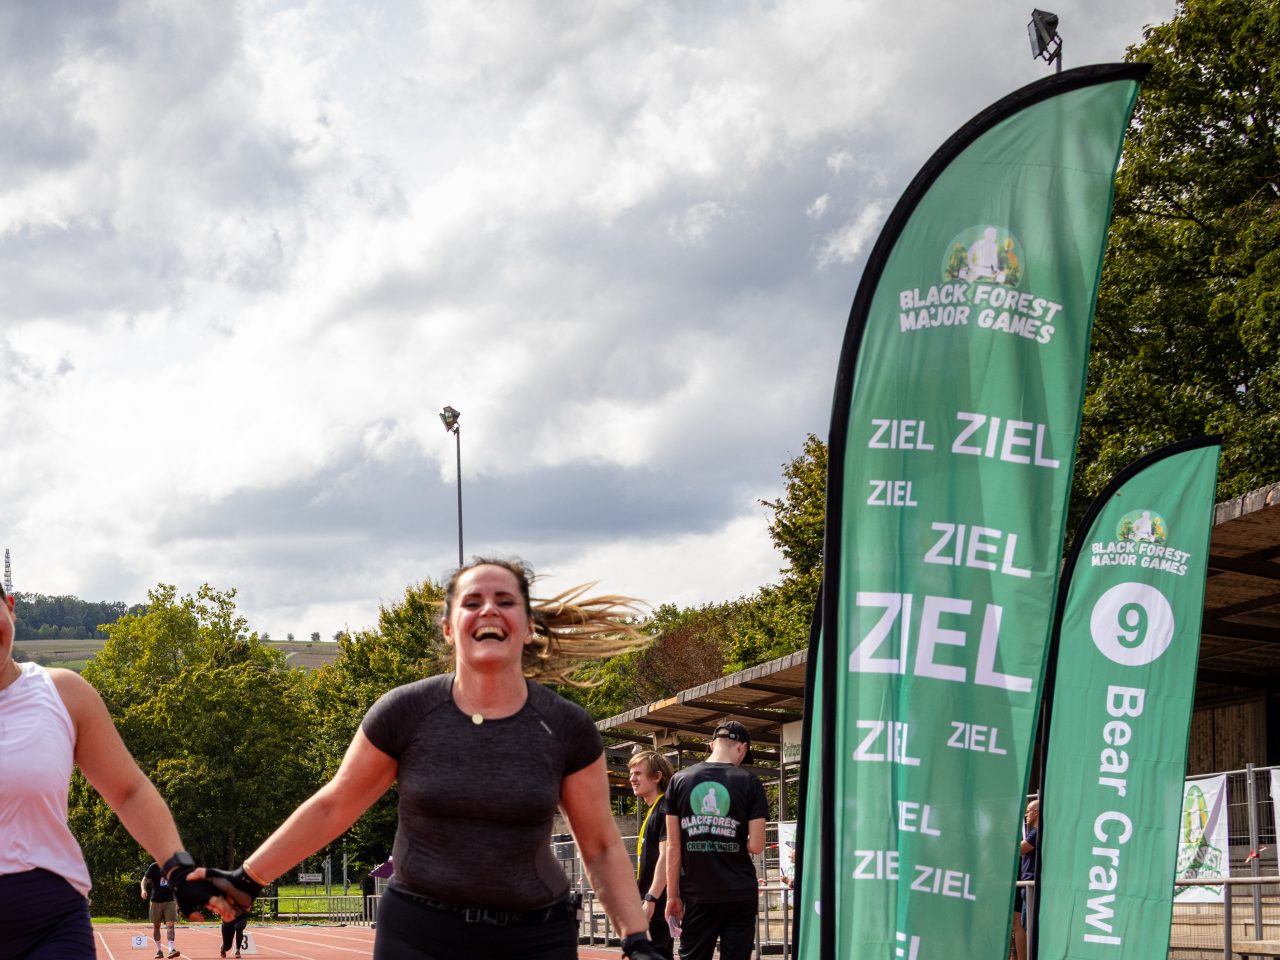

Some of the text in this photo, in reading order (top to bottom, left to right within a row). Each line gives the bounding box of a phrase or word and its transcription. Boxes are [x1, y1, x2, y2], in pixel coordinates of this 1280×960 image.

[900, 284, 1062, 322] BLACK FOREST
[900, 306, 1055, 344] MAJOR GAMES
[868, 419, 933, 450] ZIEL
[951, 412, 1059, 468] ZIEL
[867, 480, 917, 506] ZIEL
[924, 522, 1031, 578] ZIEL
[1092, 542, 1190, 563] BLACK FOREST
[1092, 554, 1188, 576] MAJOR GAMES
[849, 592, 1032, 692] ZIEL
[1117, 603, 1148, 648] 9
[947, 721, 1007, 755] ZIEL
[1099, 685, 1146, 797] Bear
[711, 826, 736, 837] GAMES
[852, 850, 899, 880] ZIE
[911, 864, 976, 900] ZIEL
[1084, 811, 1134, 945] Crawl
